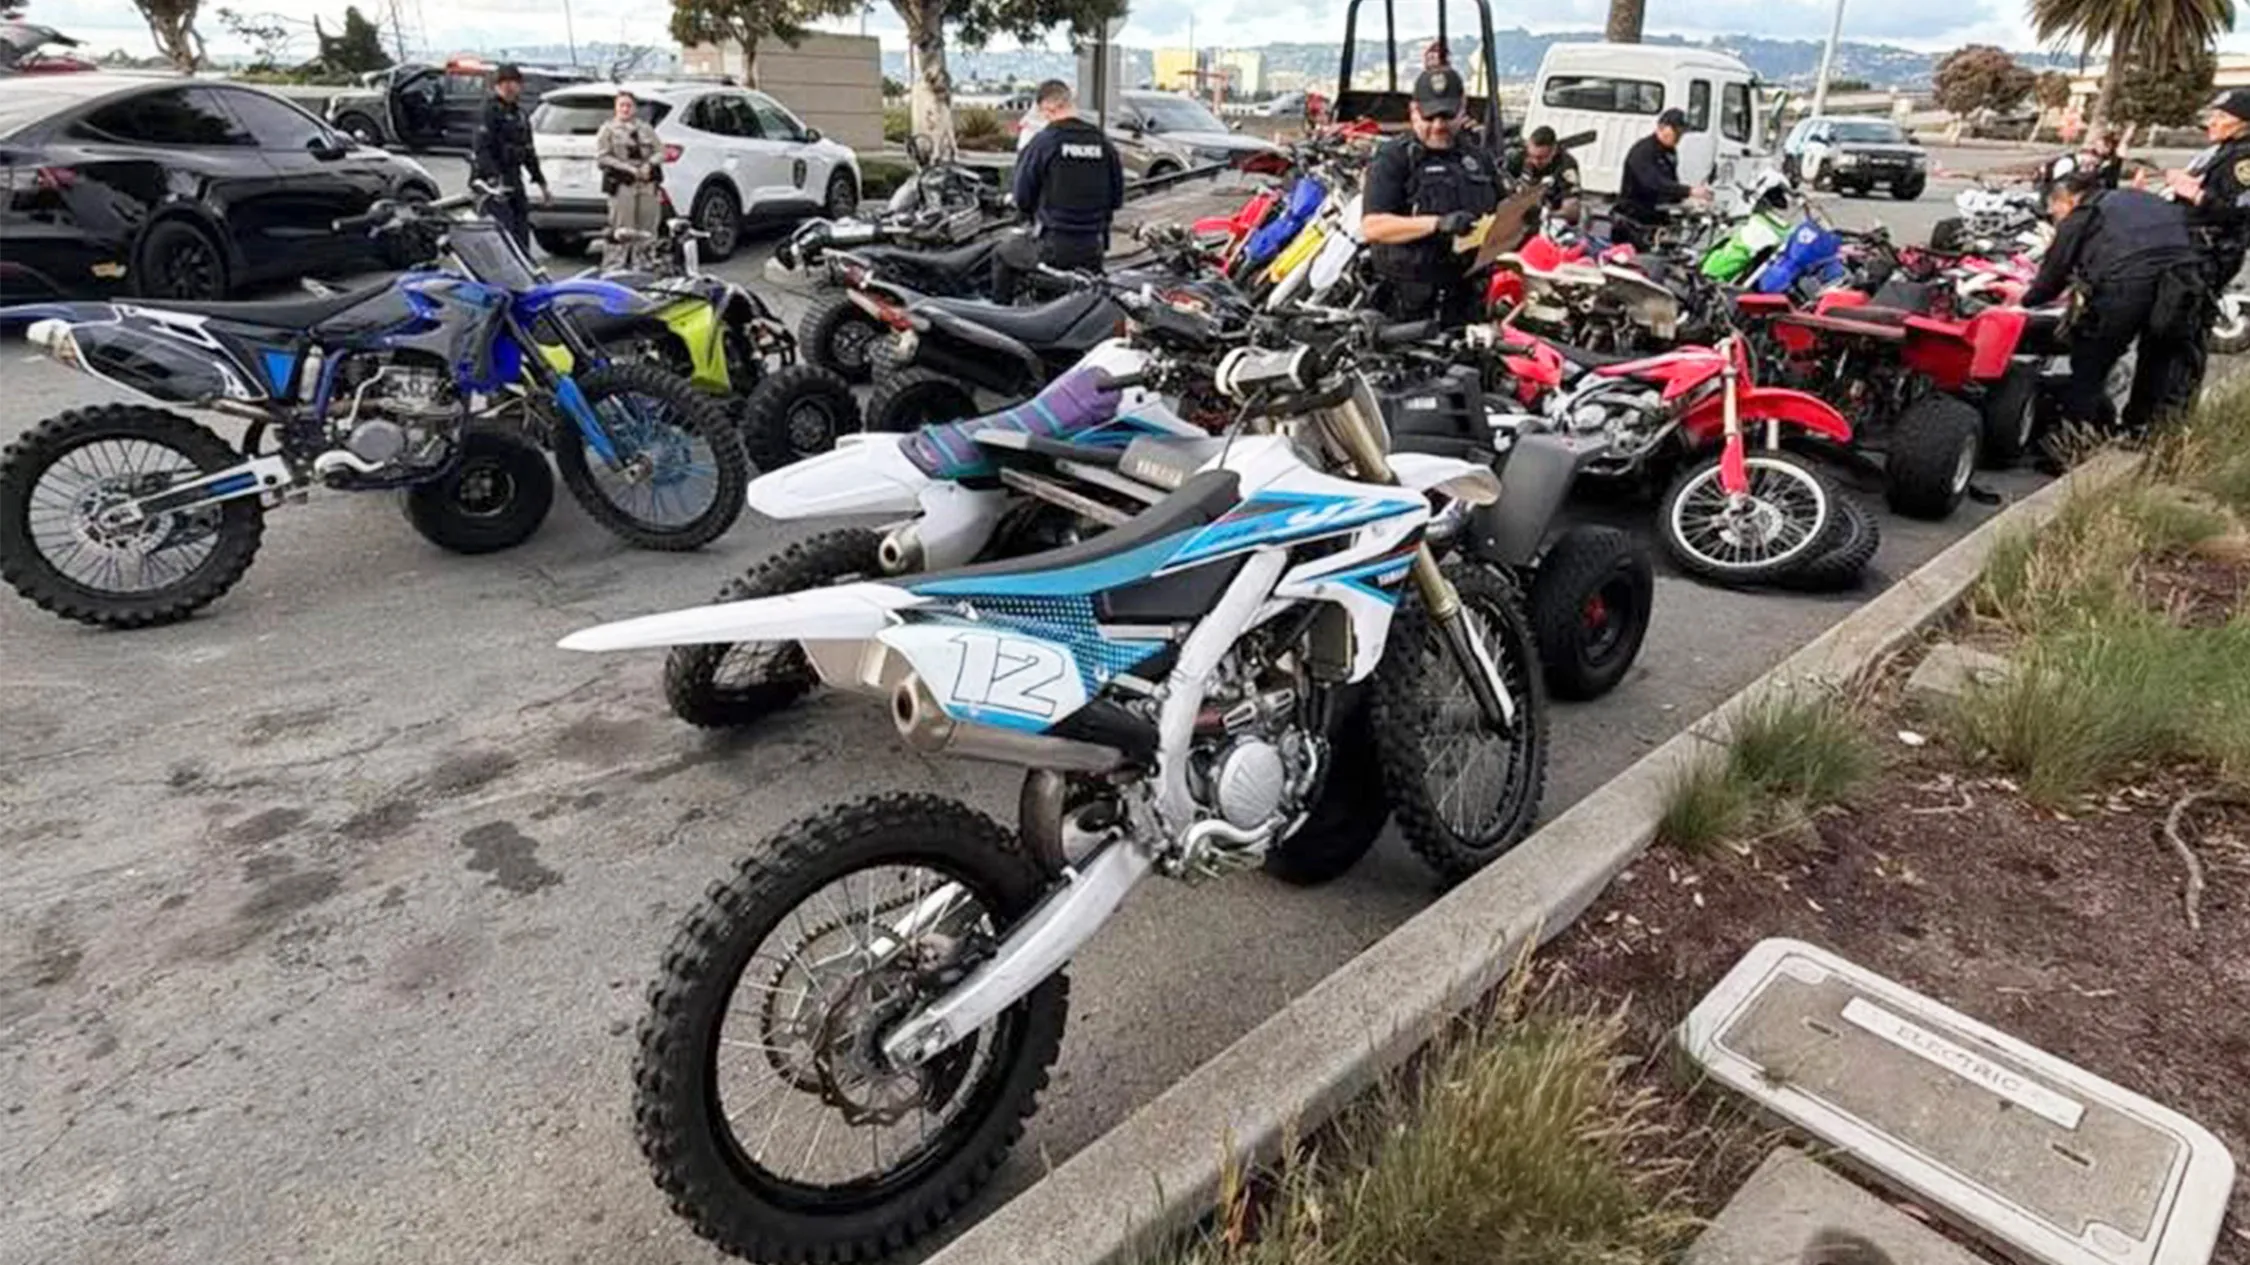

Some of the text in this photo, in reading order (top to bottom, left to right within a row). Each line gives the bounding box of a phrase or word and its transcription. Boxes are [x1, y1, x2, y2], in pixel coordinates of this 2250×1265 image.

[1061, 143, 1102, 158] POLICE
[948, 632, 1065, 718] 12
[1896, 1025, 2023, 1093] ELECTRIC
